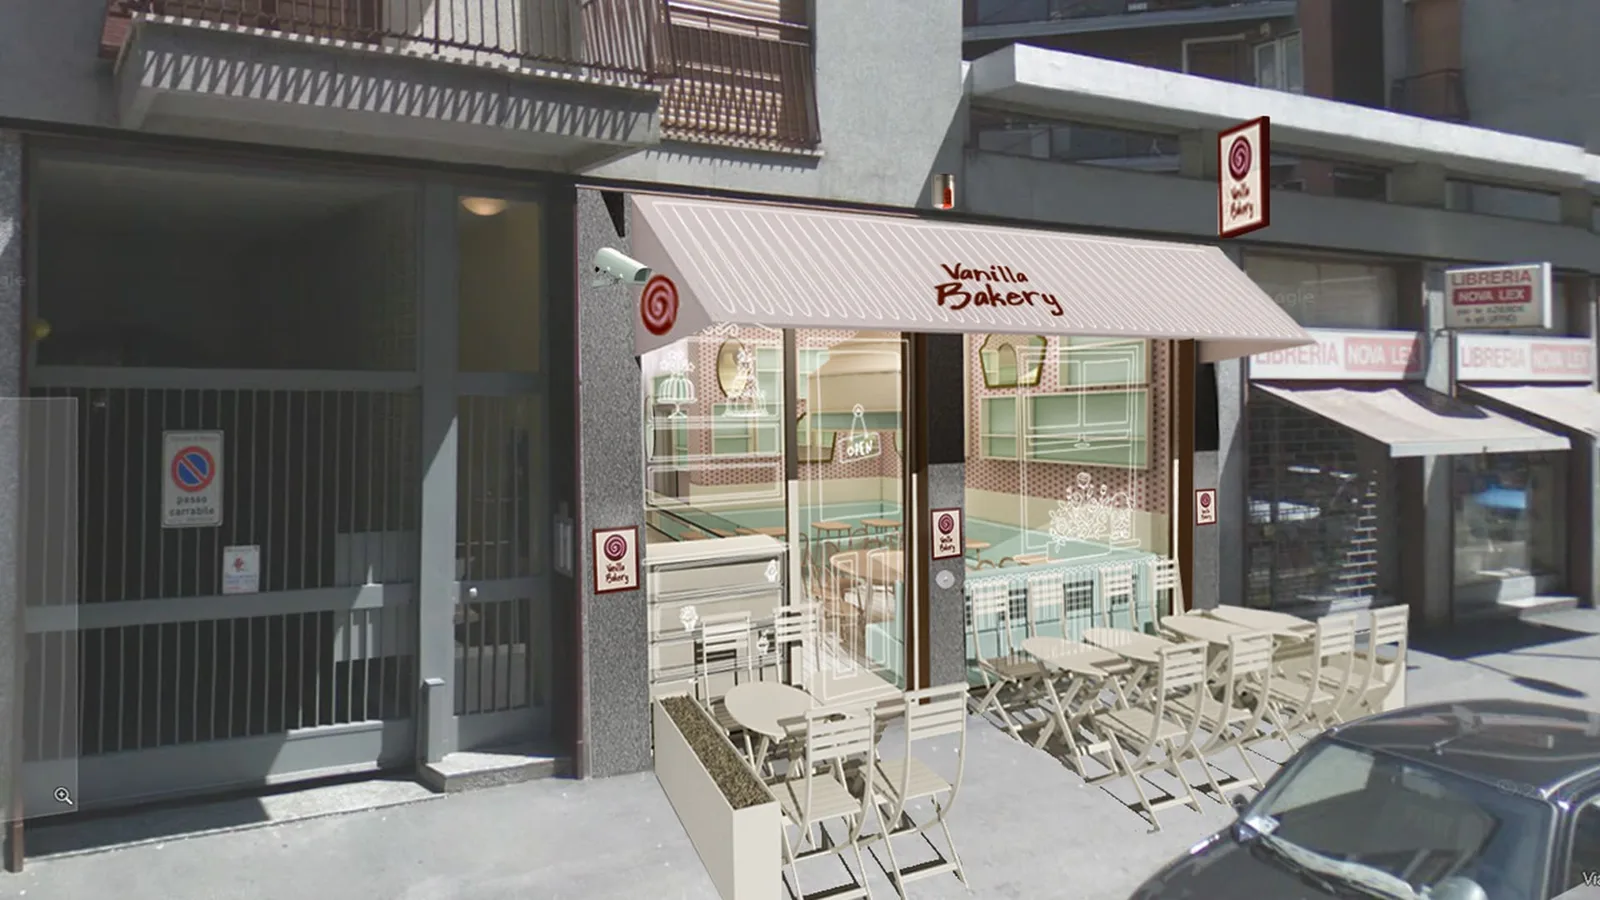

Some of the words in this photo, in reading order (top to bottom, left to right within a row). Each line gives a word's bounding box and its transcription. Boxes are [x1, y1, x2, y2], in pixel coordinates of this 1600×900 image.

[1230, 200, 1253, 221] Bakery
[942, 263, 1028, 283] Vanilla
[1452, 270, 1532, 286] LIBRERIA
[935, 282, 1064, 317] Bakery
[1458, 290, 1494, 303] NOVA
[1499, 288, 1526, 301] LEX
[1348, 343, 1386, 365] NOVA
[1461, 346, 1525, 368] LIBRERIA
[847, 439, 873, 457] OPEN
[175, 496, 208, 506] passo
[169, 506, 215, 517] carrabile
[606, 562, 625, 572] Vanilla
[605, 572, 629, 585] Bakery
